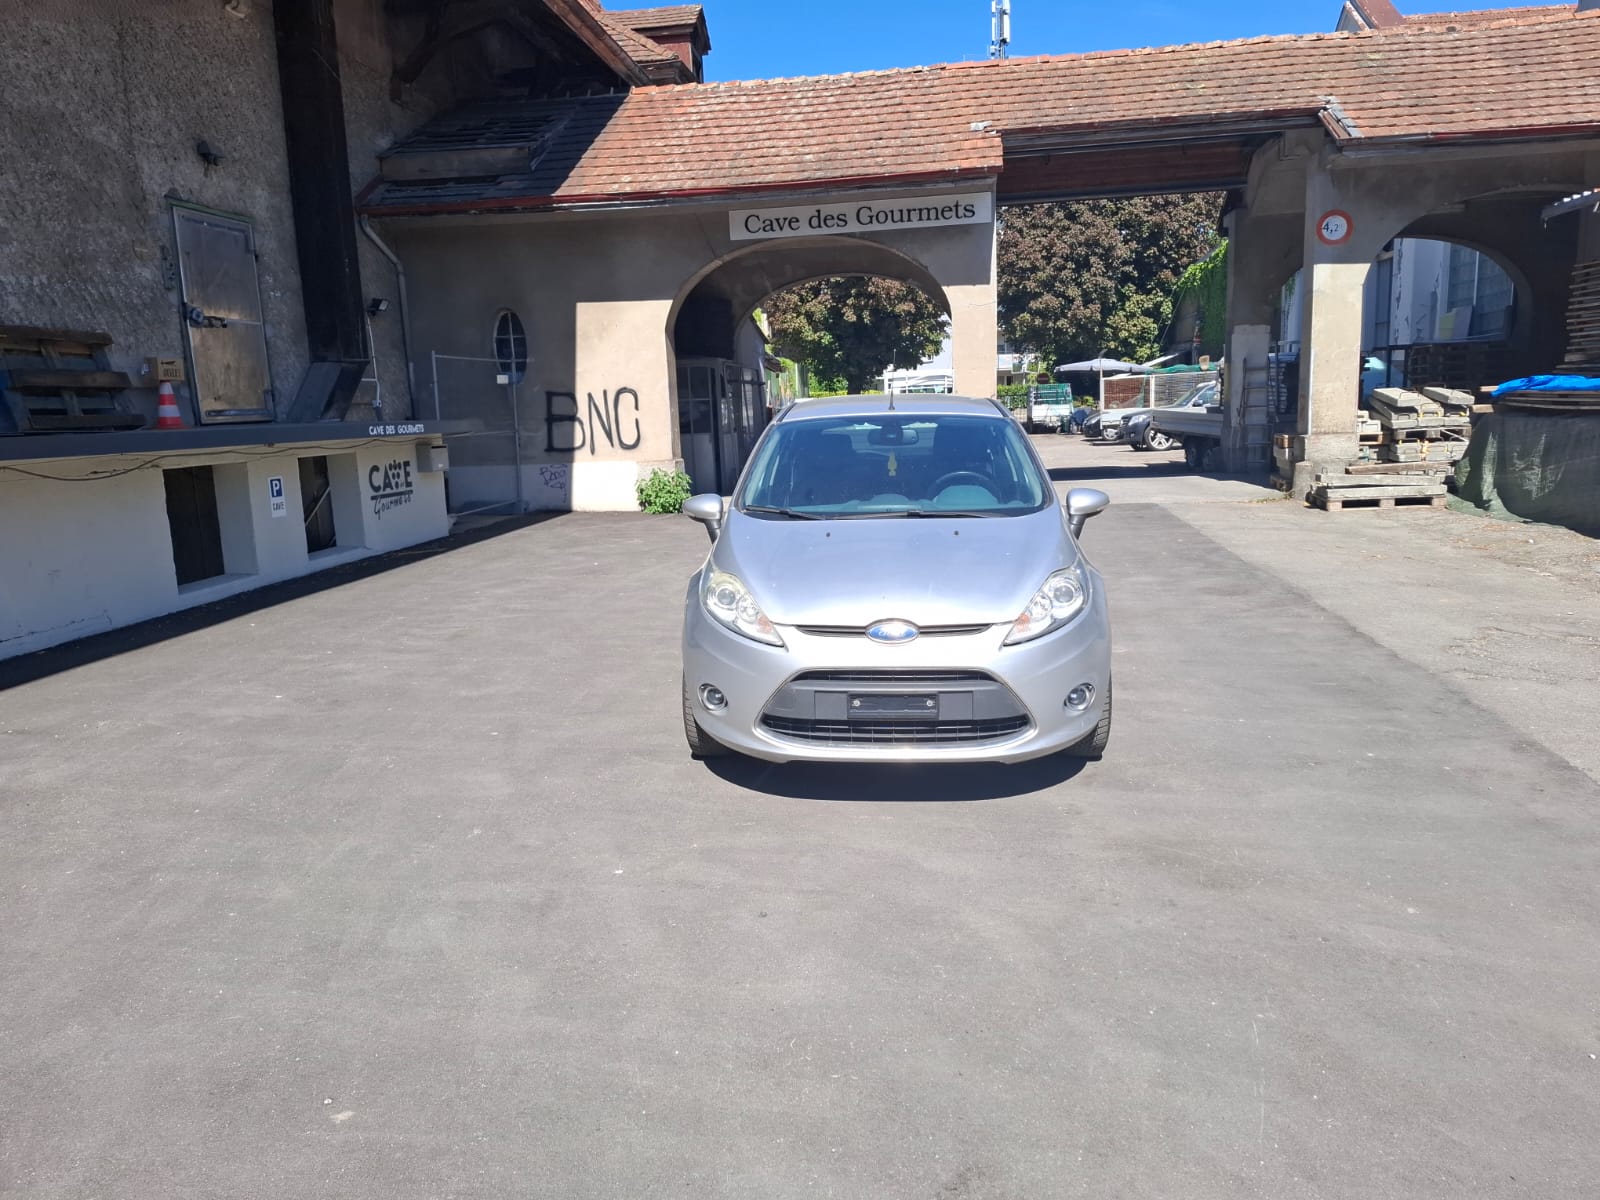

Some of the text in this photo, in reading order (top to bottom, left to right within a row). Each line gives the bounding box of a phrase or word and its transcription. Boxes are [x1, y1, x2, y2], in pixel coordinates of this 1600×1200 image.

[744, 200, 976, 234] Cave des Gourmets
[368, 424, 425, 435] CAVE DES GOURMETS
[544, 387, 641, 456] BNC
[272, 480, 280, 497] P
